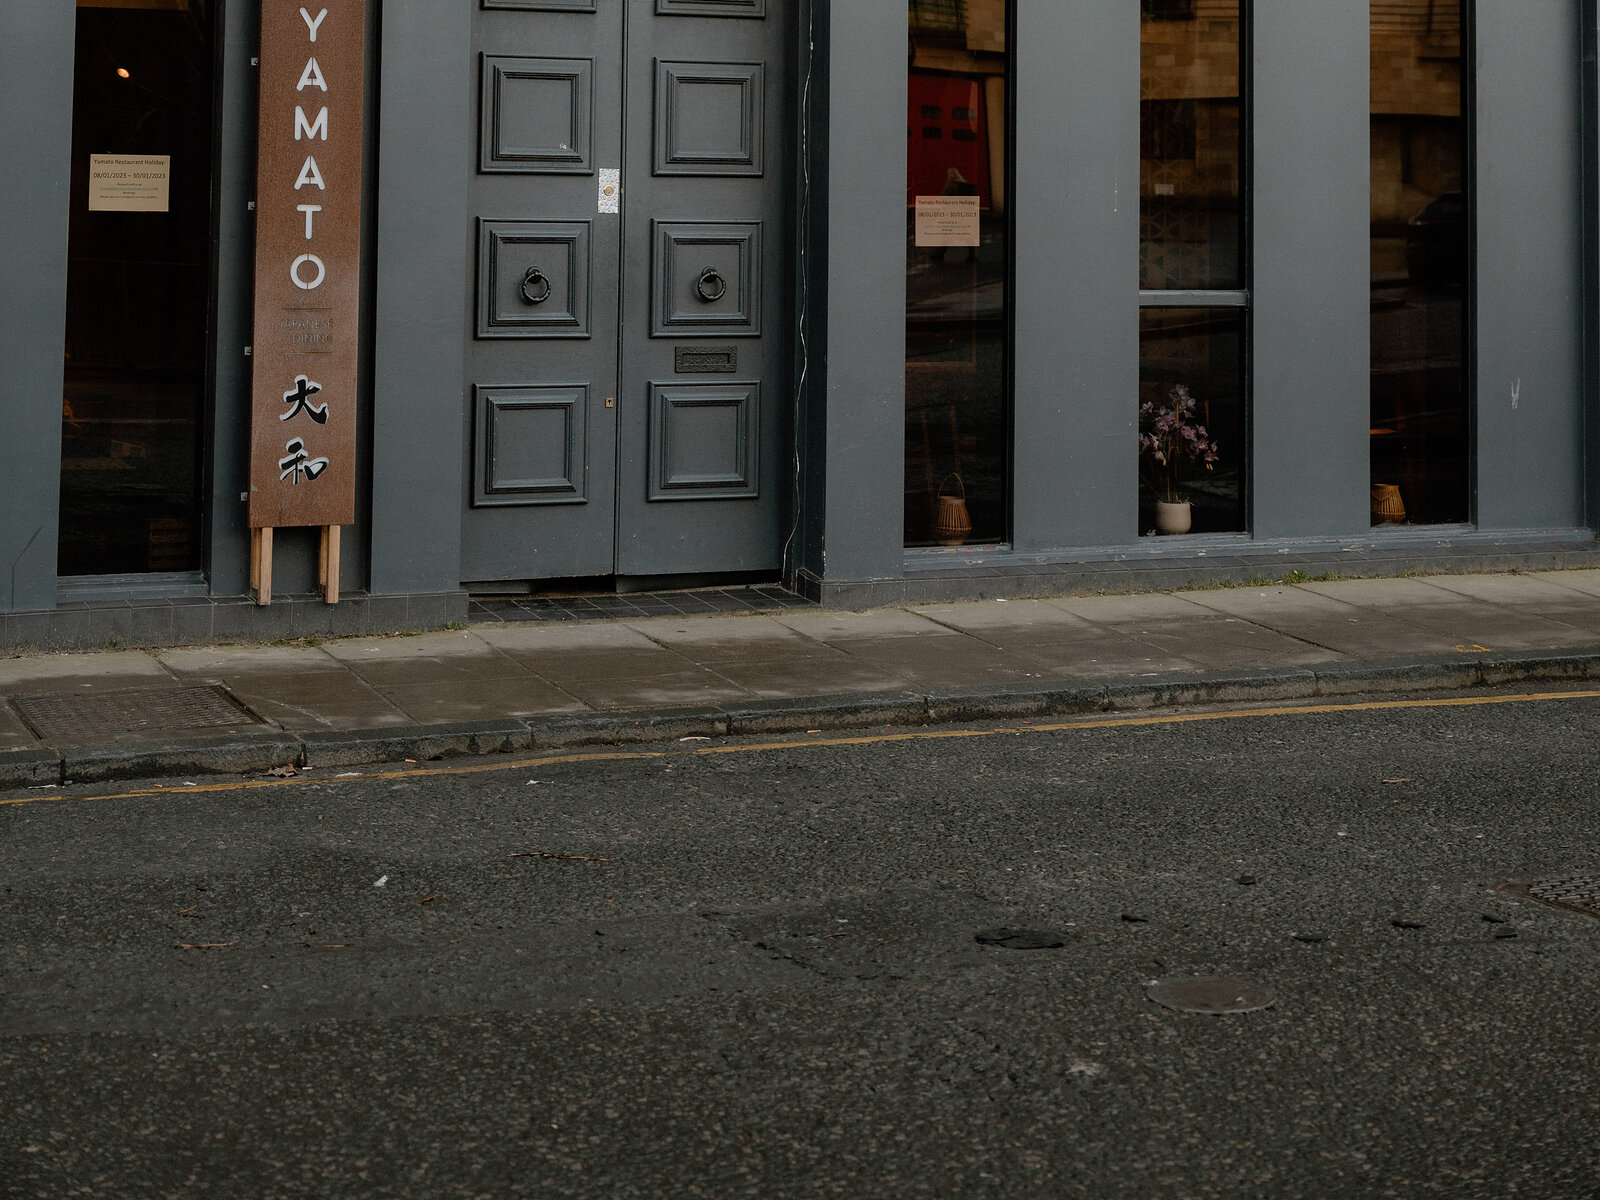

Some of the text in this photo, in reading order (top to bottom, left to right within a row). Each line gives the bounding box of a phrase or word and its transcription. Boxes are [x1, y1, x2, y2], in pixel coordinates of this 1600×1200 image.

[290, 7, 328, 290] YAMATO
[280, 319, 334, 329] JAPANESE
[292, 334, 334, 344] DINING
[279, 374, 330, 485] 大和
